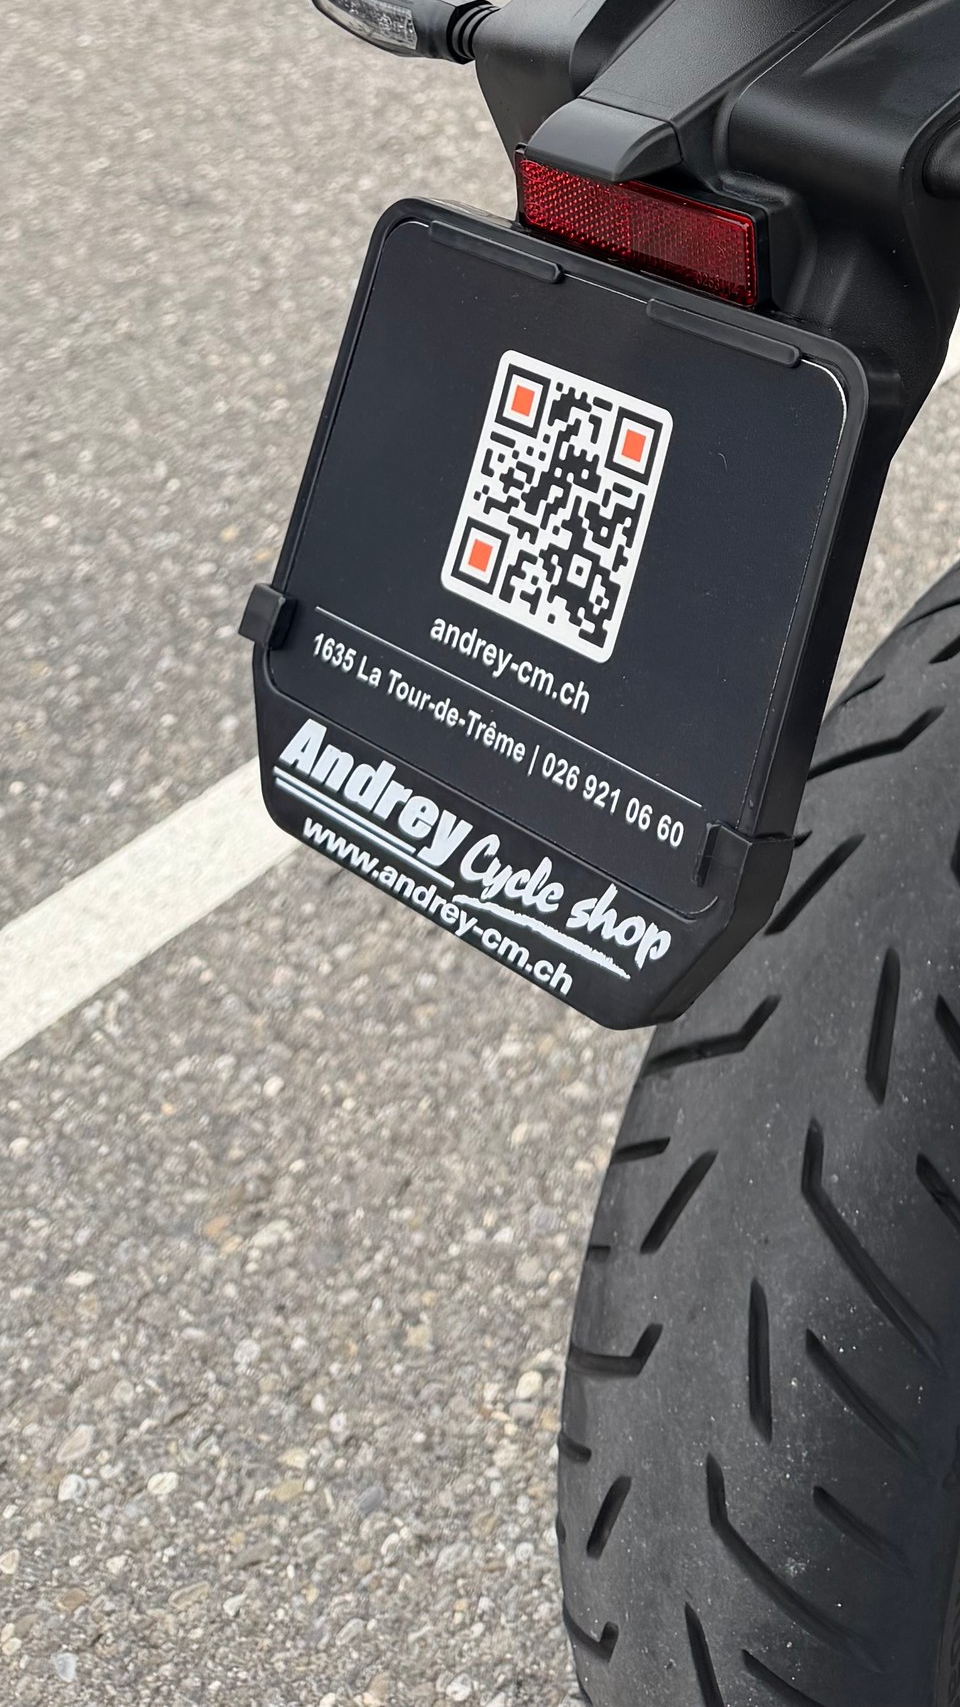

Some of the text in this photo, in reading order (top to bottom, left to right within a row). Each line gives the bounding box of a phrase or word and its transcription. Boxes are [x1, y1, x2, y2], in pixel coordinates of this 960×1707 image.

[313, 632, 357, 673] 1635
[356, 655, 382, 688] La
[387, 668, 526, 763] Tour-de-Trême
[541, 752, 581, 791] 026
[582, 774, 621, 814] 921
[625, 797, 653, 831] 06
[656, 814, 685, 848] 60
[430, 617, 590, 715] andrey-cm.ch
[278, 718, 672, 970] Andrey Cycle shop
[302, 817, 574, 996] www.andrey-cm.ch
